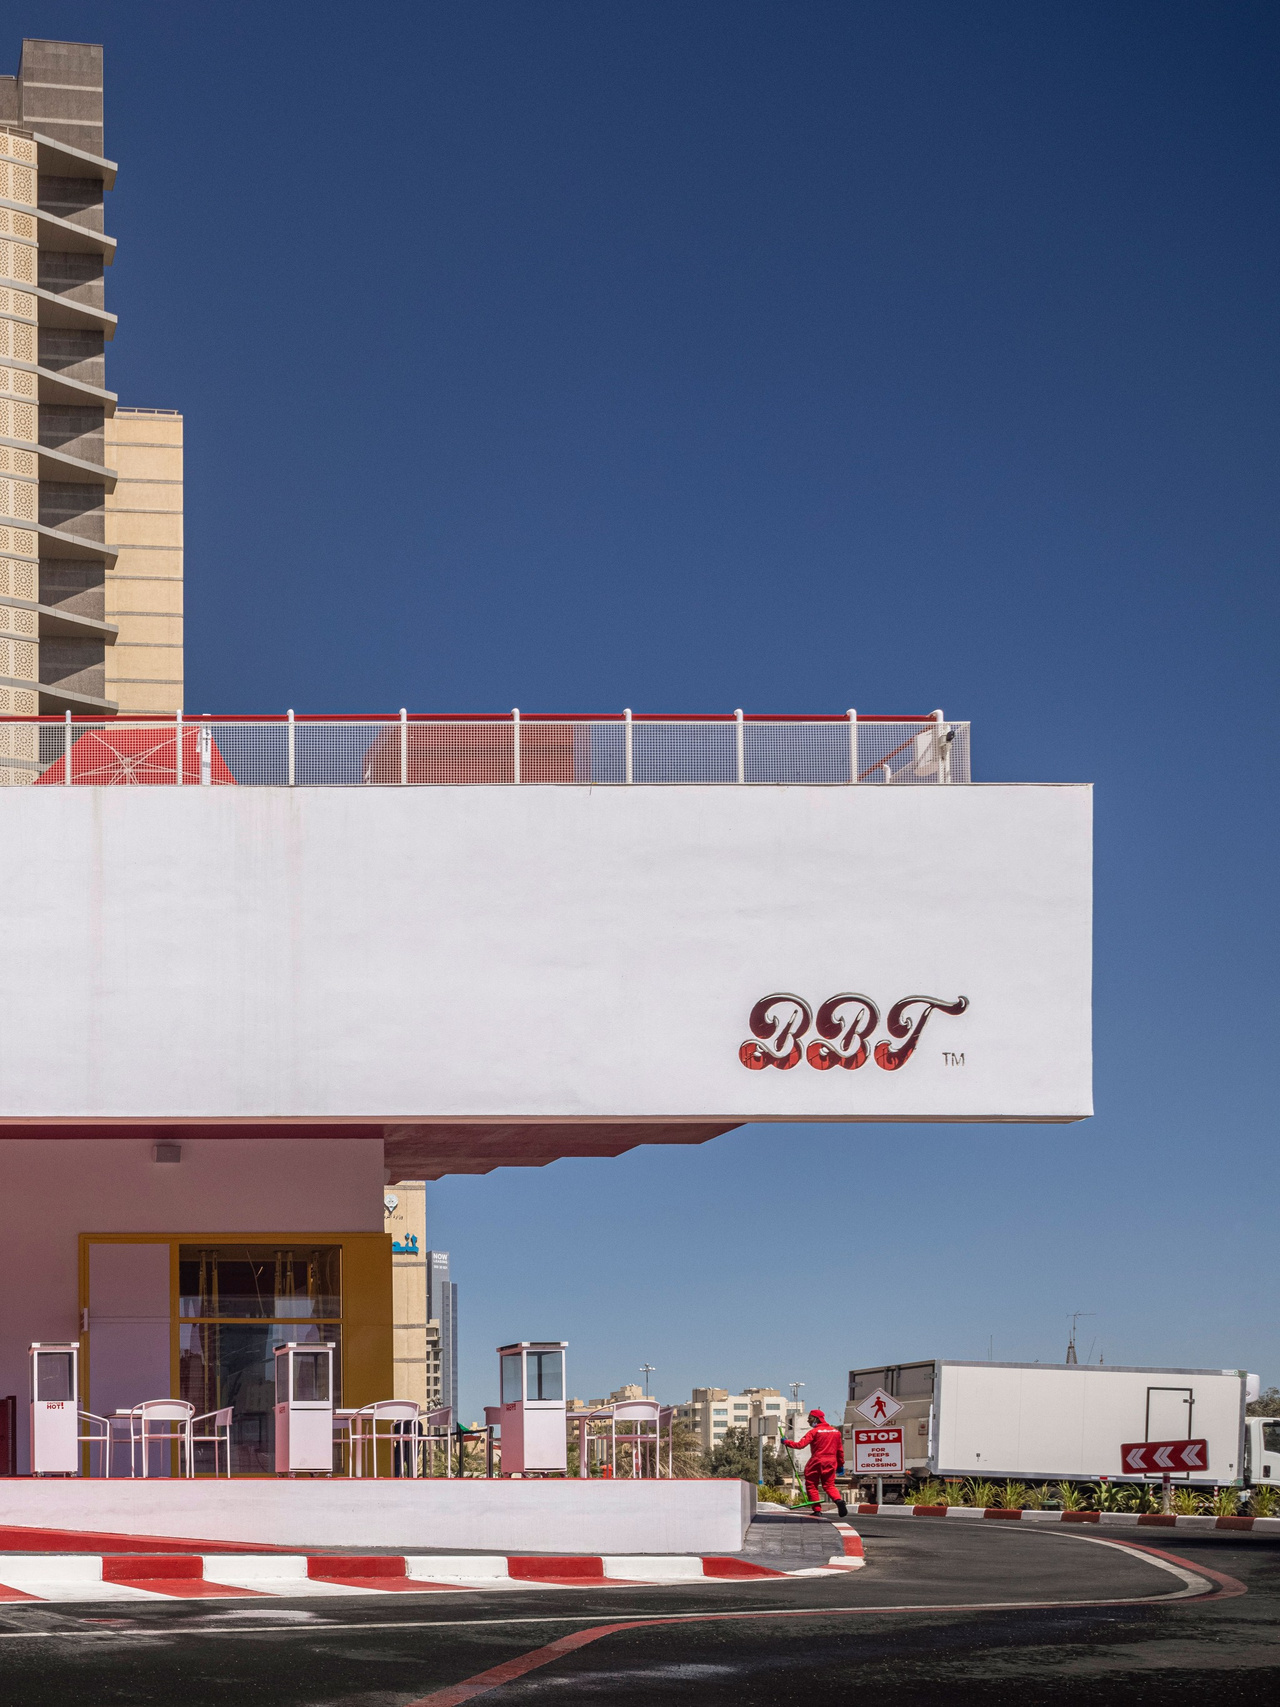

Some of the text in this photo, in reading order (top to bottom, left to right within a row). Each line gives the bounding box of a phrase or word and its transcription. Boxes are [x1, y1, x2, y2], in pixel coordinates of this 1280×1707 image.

[739, 992, 970, 1071] BBT TM
[859, 1431, 899, 1442] STOP
